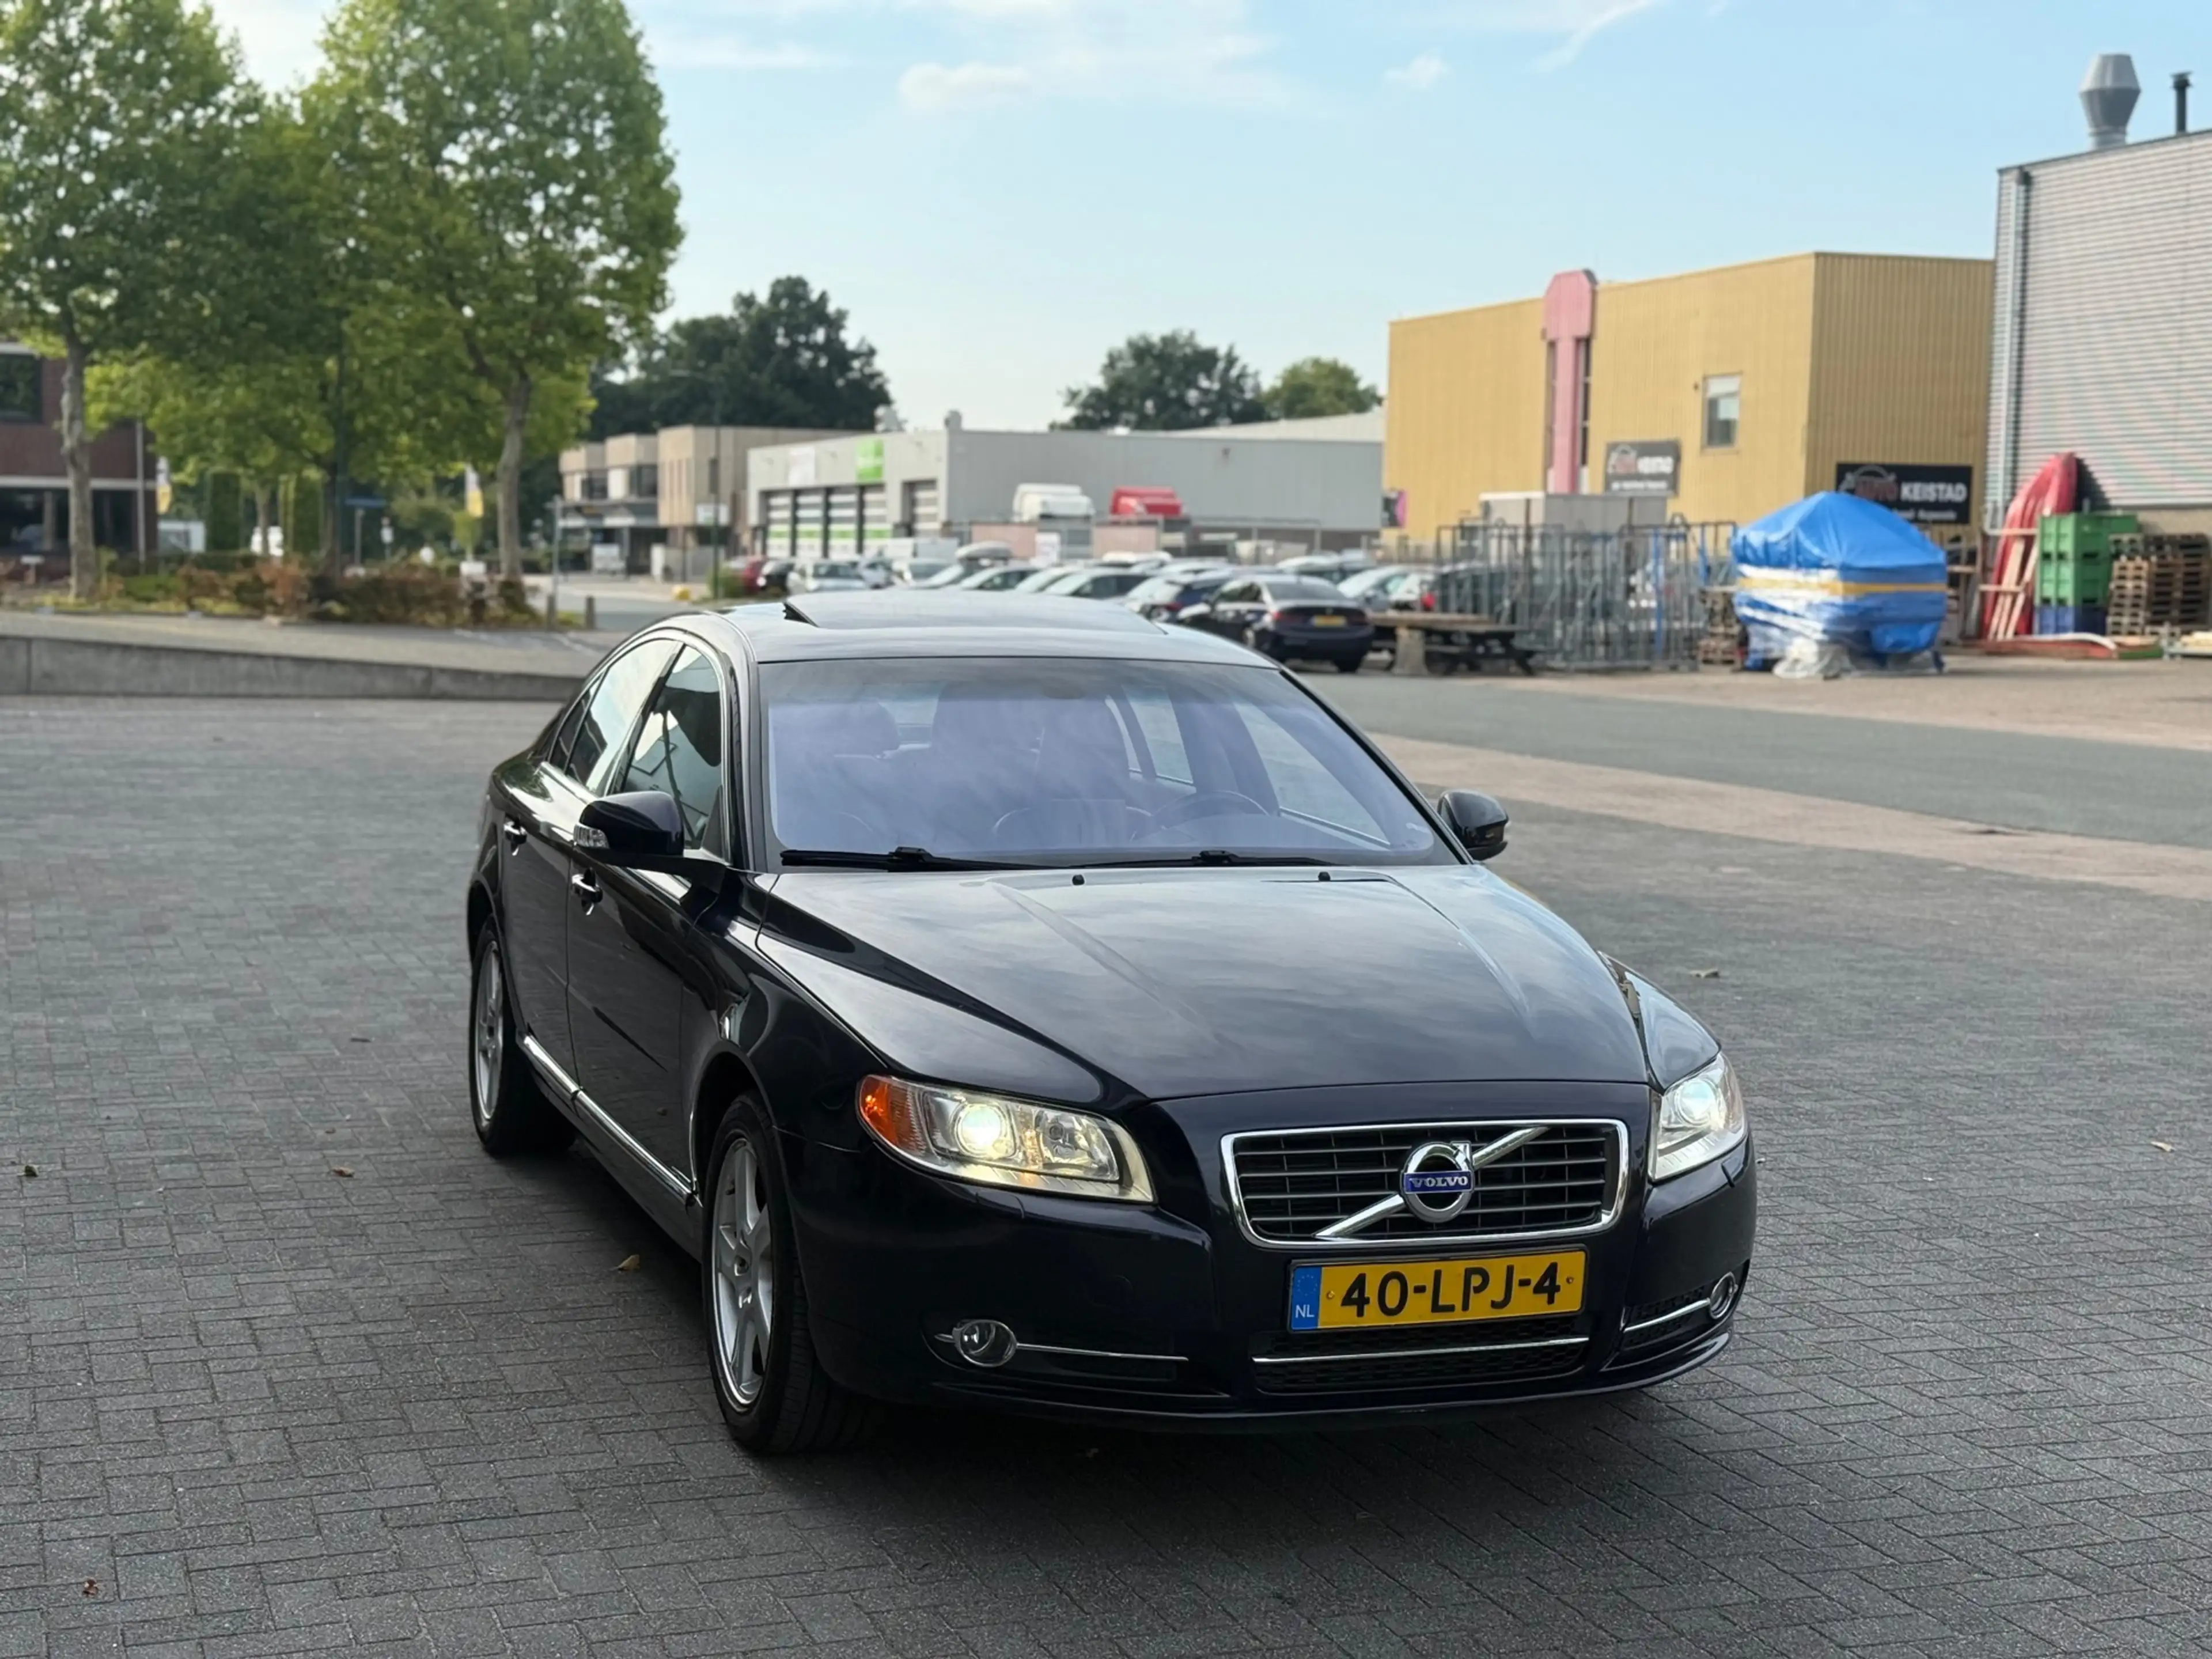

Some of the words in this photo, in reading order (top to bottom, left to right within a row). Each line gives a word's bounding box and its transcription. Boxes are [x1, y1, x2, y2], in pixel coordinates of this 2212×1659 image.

[1901, 482, 1967, 503] KEISTAD
[1409, 1176, 1468, 1188] VOLVO
[1296, 1304, 1315, 1318] NL
[1340, 1262, 1561, 1318] 40-LPJ-4
